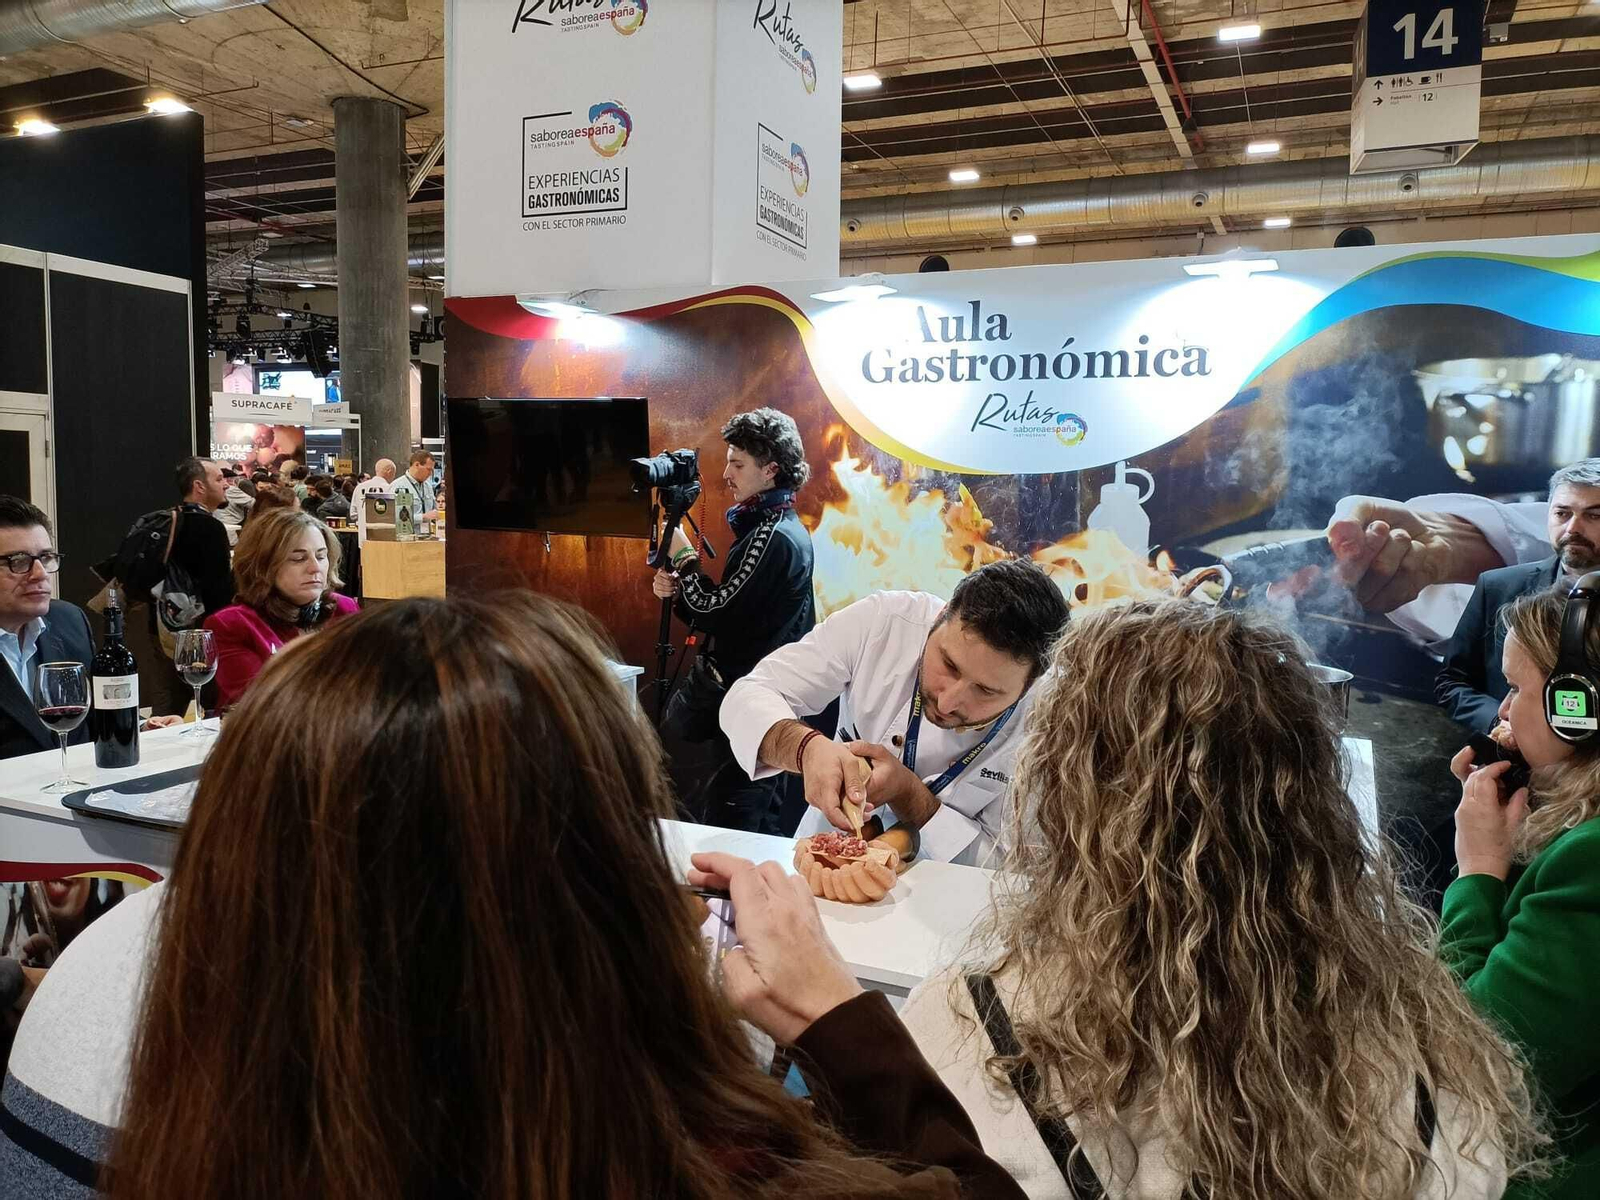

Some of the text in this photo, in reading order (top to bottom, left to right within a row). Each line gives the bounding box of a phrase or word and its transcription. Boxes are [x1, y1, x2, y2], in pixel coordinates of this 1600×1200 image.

[753, 0, 804, 53] Rutas
[1393, 8, 1459, 60] 14
[1422, 93, 1435, 102] 12
[530, 122, 616, 143] saboreaespaña
[528, 167, 620, 190] EXPERIENCIAS
[528, 187, 620, 209] GASTRONÓMICAS
[760, 185, 804, 222] EXPERIENCIAS
[522, 214, 627, 231] CON EL SECTOR PRIMARIO
[862, 335, 1212, 384] Gastronómica
[971, 390, 1059, 432] Rutas
[217, 443, 230, 452] LO
[231, 444, 252, 452] QUE
[962, 742, 987, 765] makro
